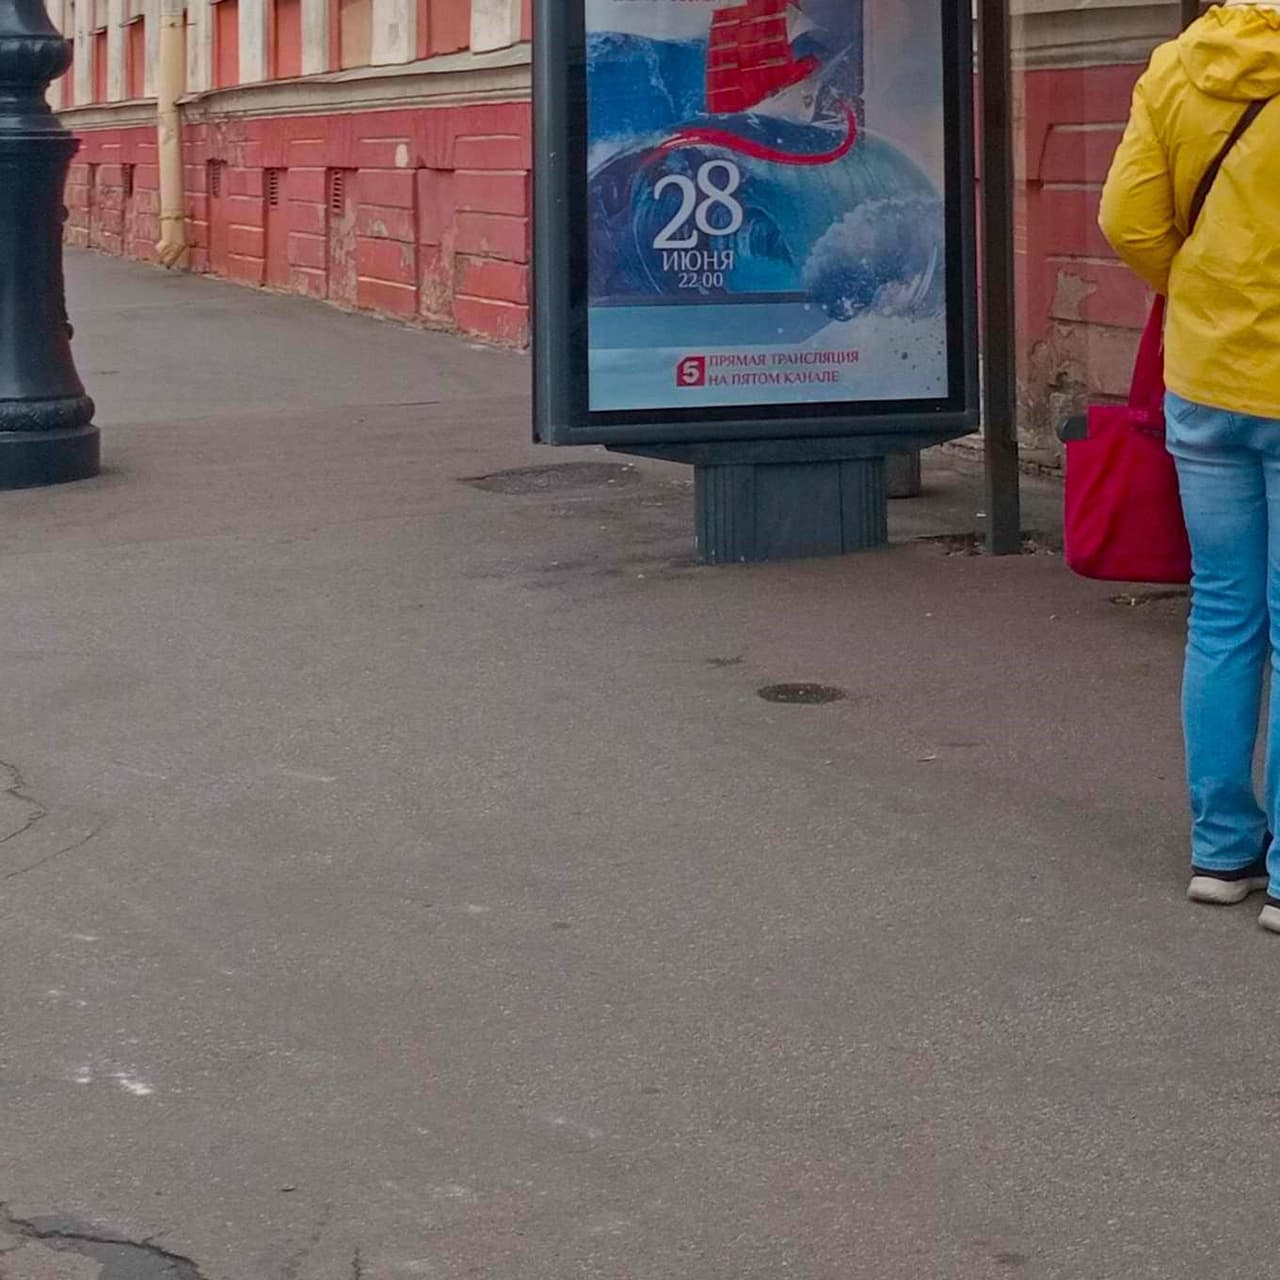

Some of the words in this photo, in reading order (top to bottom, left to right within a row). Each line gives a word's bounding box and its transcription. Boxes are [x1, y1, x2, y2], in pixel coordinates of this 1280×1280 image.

[652, 159, 744, 249] 28
[663, 250, 734, 271] ИЮНЯ
[709, 354, 766, 367] ПРЯМАЯ
[771, 351, 859, 365] ТРАНСЛЯЦИЯ
[709, 373, 727, 386] НА
[732, 372, 780, 385] ПЯТОМ
[783, 370, 839, 384] КАНАЛЕ
